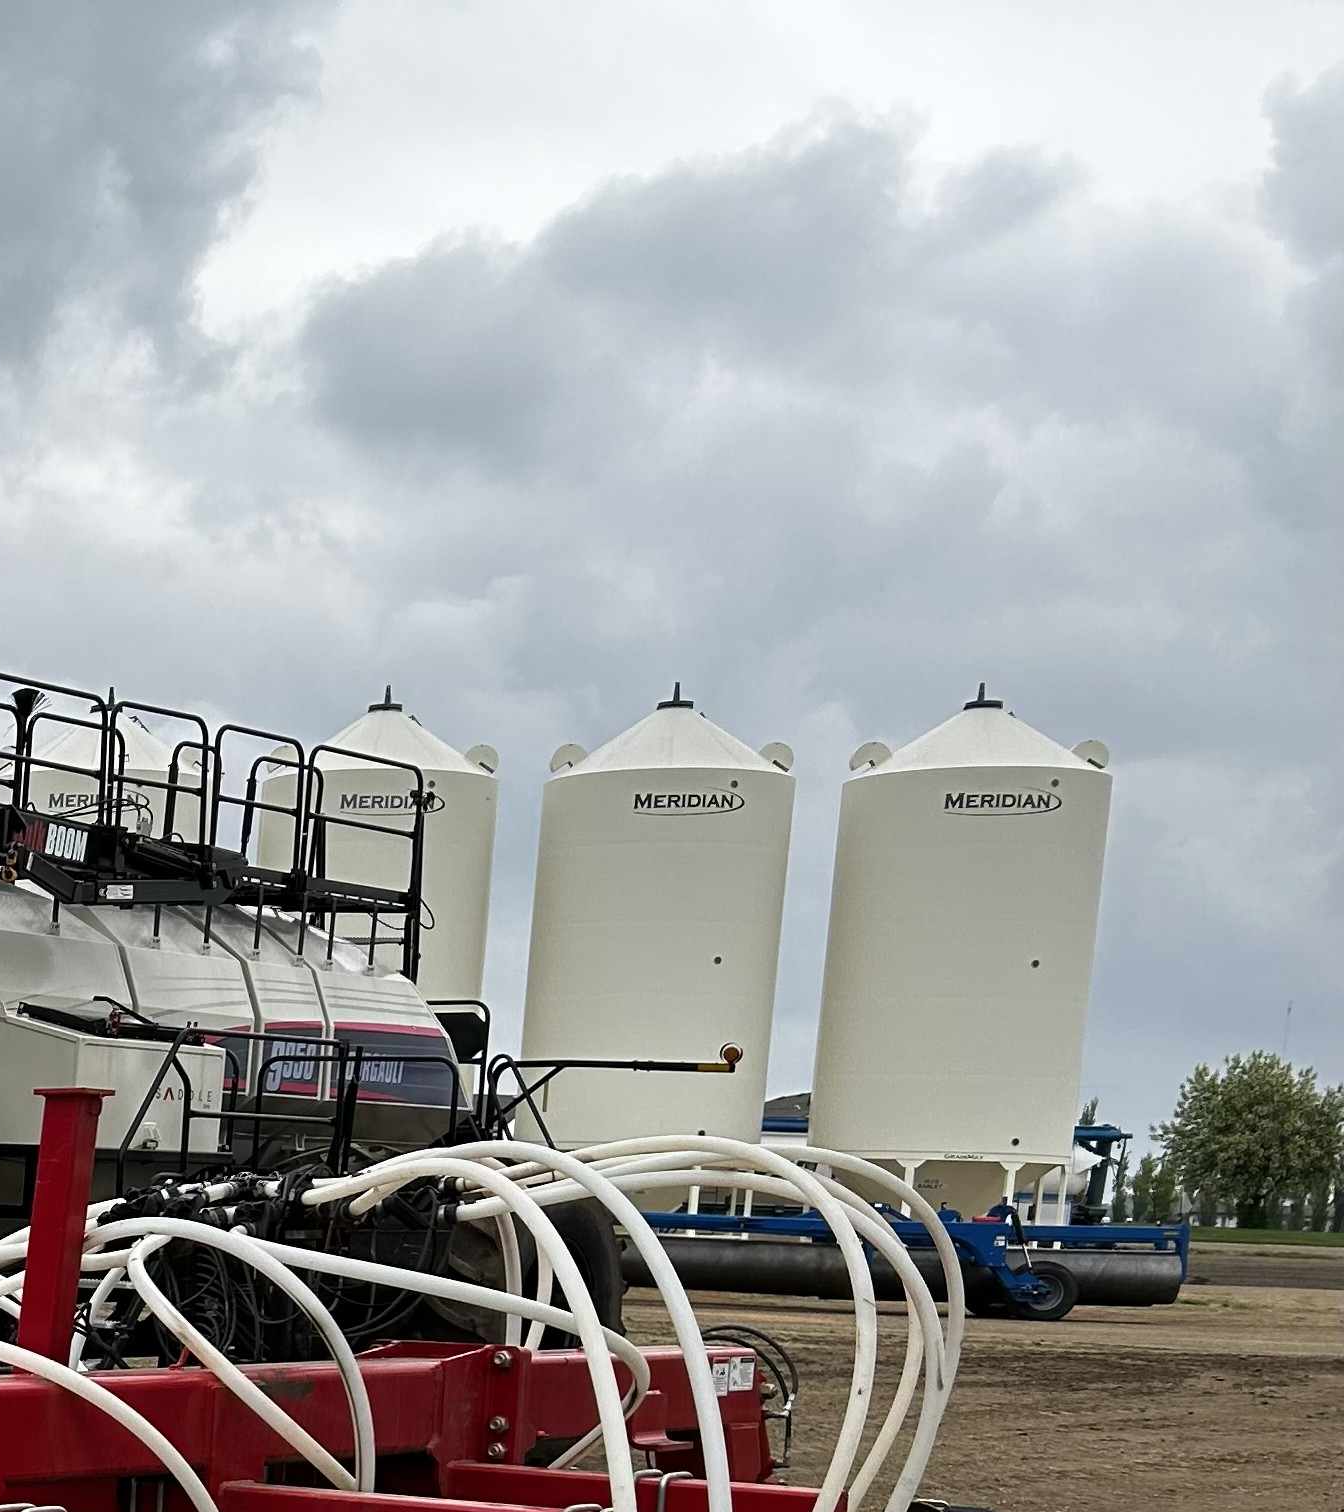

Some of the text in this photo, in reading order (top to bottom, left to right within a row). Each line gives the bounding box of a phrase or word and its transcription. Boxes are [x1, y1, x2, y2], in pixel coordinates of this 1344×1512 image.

[48, 793, 140, 809] MERIN
[633, 793, 734, 810] MERIDIAN
[944, 792, 1051, 810] MERIDIAN
[44, 822, 88, 863] BOOM
[336, 1050, 405, 1085] ORGAULT
